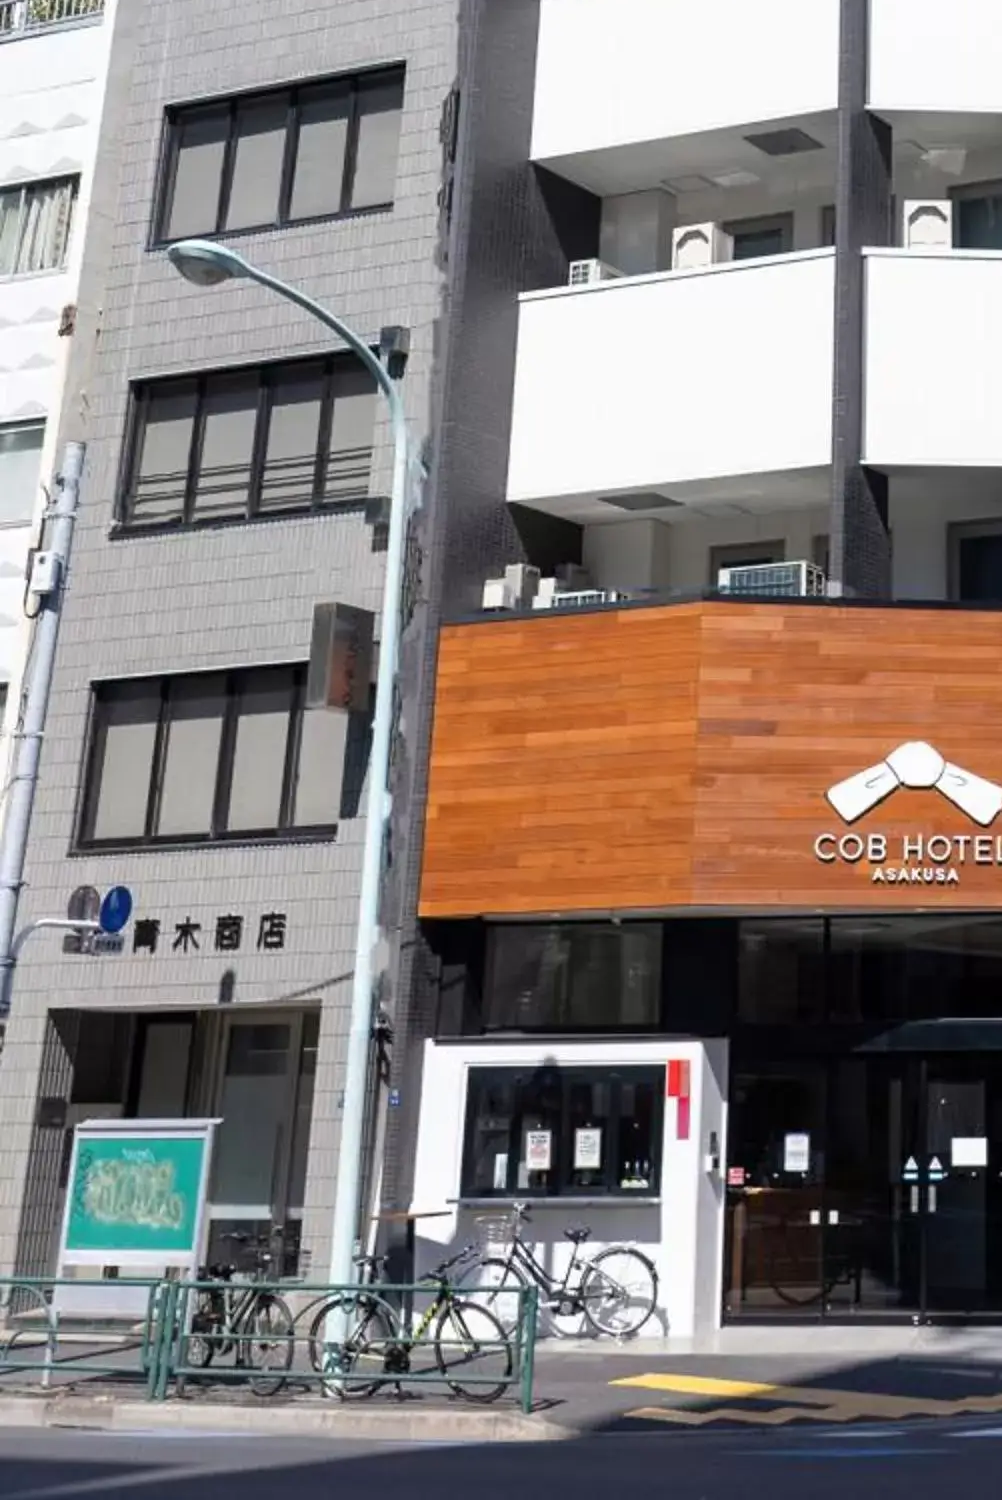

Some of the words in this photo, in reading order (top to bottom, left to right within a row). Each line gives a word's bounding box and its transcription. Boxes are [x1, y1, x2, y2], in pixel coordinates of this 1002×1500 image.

[814, 833, 887, 862] COB
[872, 867, 960, 882] ASAKUSA
[133, 912, 287, 953] 青木商店
